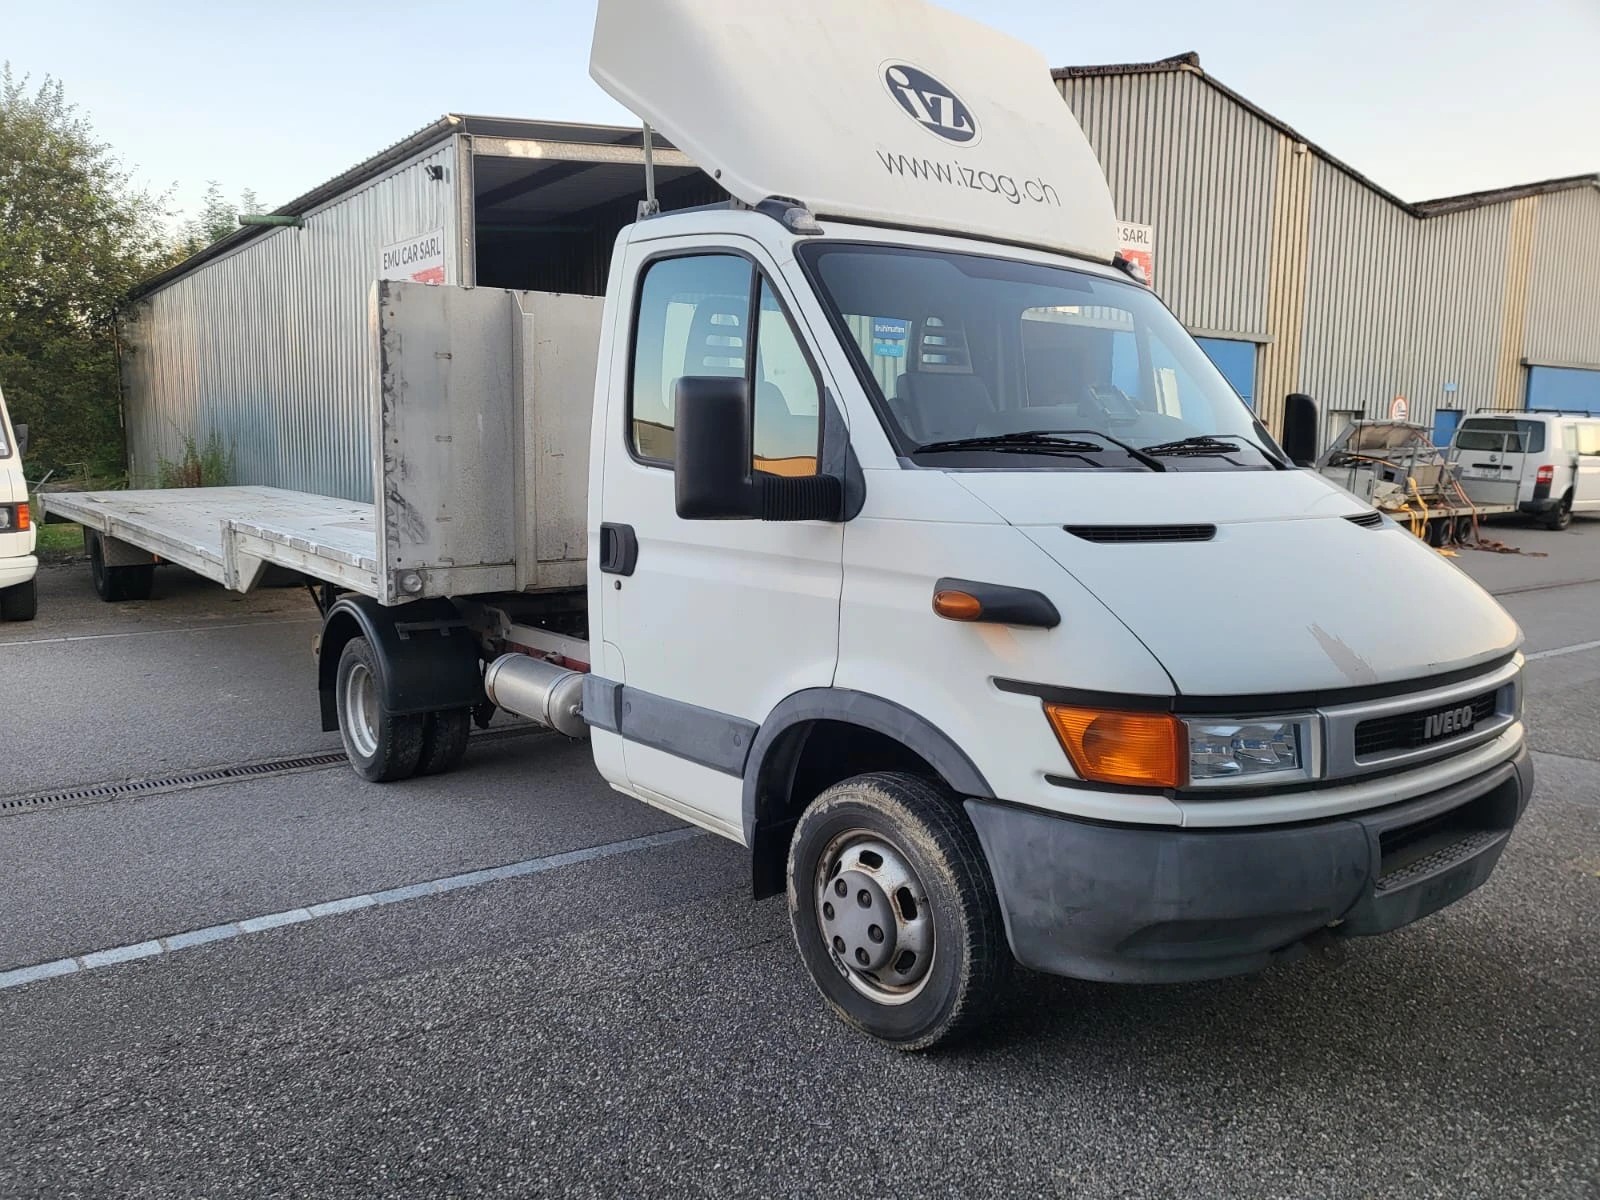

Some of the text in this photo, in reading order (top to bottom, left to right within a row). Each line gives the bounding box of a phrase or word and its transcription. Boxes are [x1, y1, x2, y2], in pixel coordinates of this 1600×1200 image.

[876, 150, 1061, 206] www.izag.ch
[1122, 227, 1150, 244] SARL
[384, 237, 440, 270] EMU CAR SARL
[1424, 705, 1473, 739] IVECO
